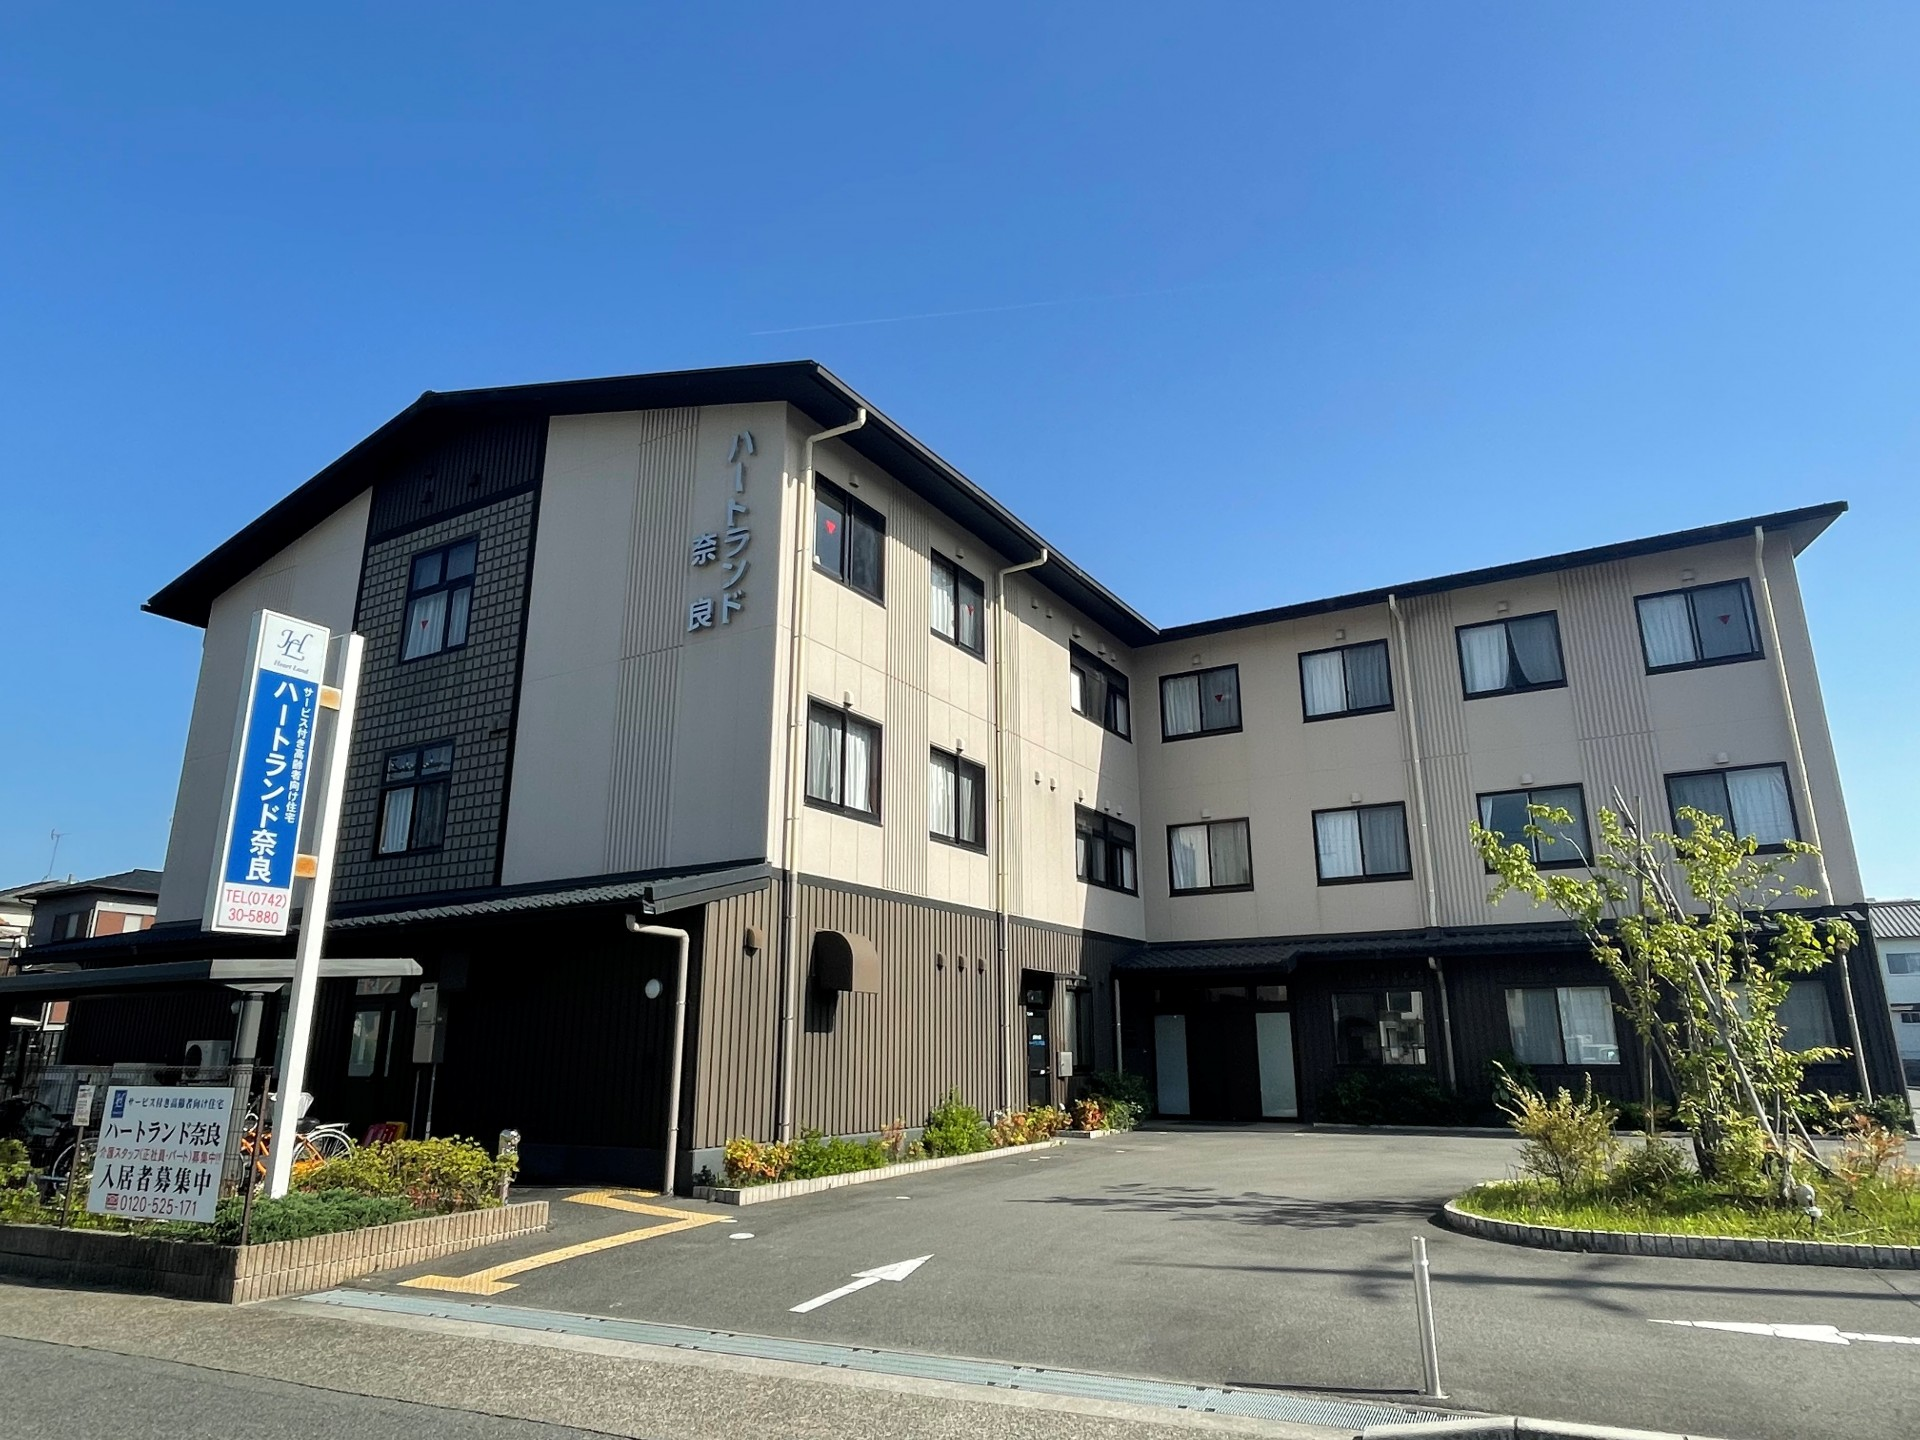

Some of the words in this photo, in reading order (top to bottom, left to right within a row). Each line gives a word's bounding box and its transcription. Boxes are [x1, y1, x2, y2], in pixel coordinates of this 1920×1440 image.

[722, 431, 755, 625] ハートランド
[687, 533, 719, 633] 奈良
[284, 686, 314, 824] サービス付き高齢者向け住宅
[245, 681, 299, 884] ハートランド奈良
[225, 889, 287, 909] TEL(0742)
[228, 908, 279, 925] 30-5880
[104, 1120, 221, 1147] ハートランド奈良
[98, 1164, 212, 1196] 入居者募集中
[119, 1195, 197, 1217] 0120-525-171
